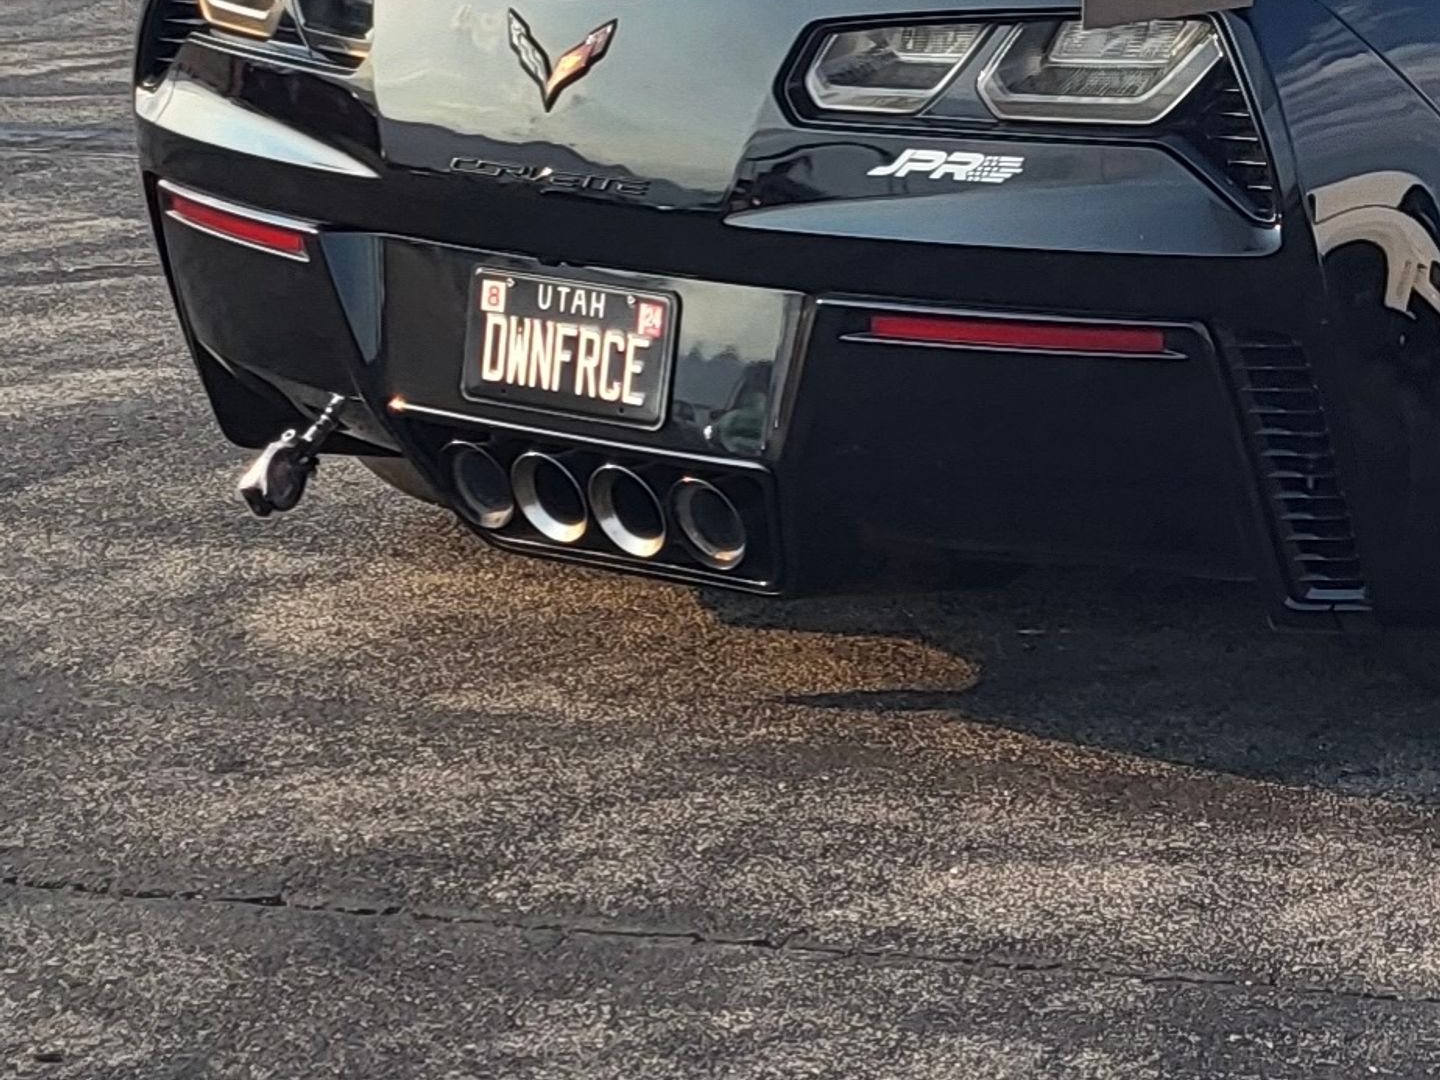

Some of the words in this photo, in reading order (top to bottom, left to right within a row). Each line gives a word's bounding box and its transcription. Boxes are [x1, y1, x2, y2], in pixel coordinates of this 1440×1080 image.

[487, 285, 501, 307] 8
[538, 284, 606, 319] UTAH
[481, 312, 651, 407] DWNFRCE
